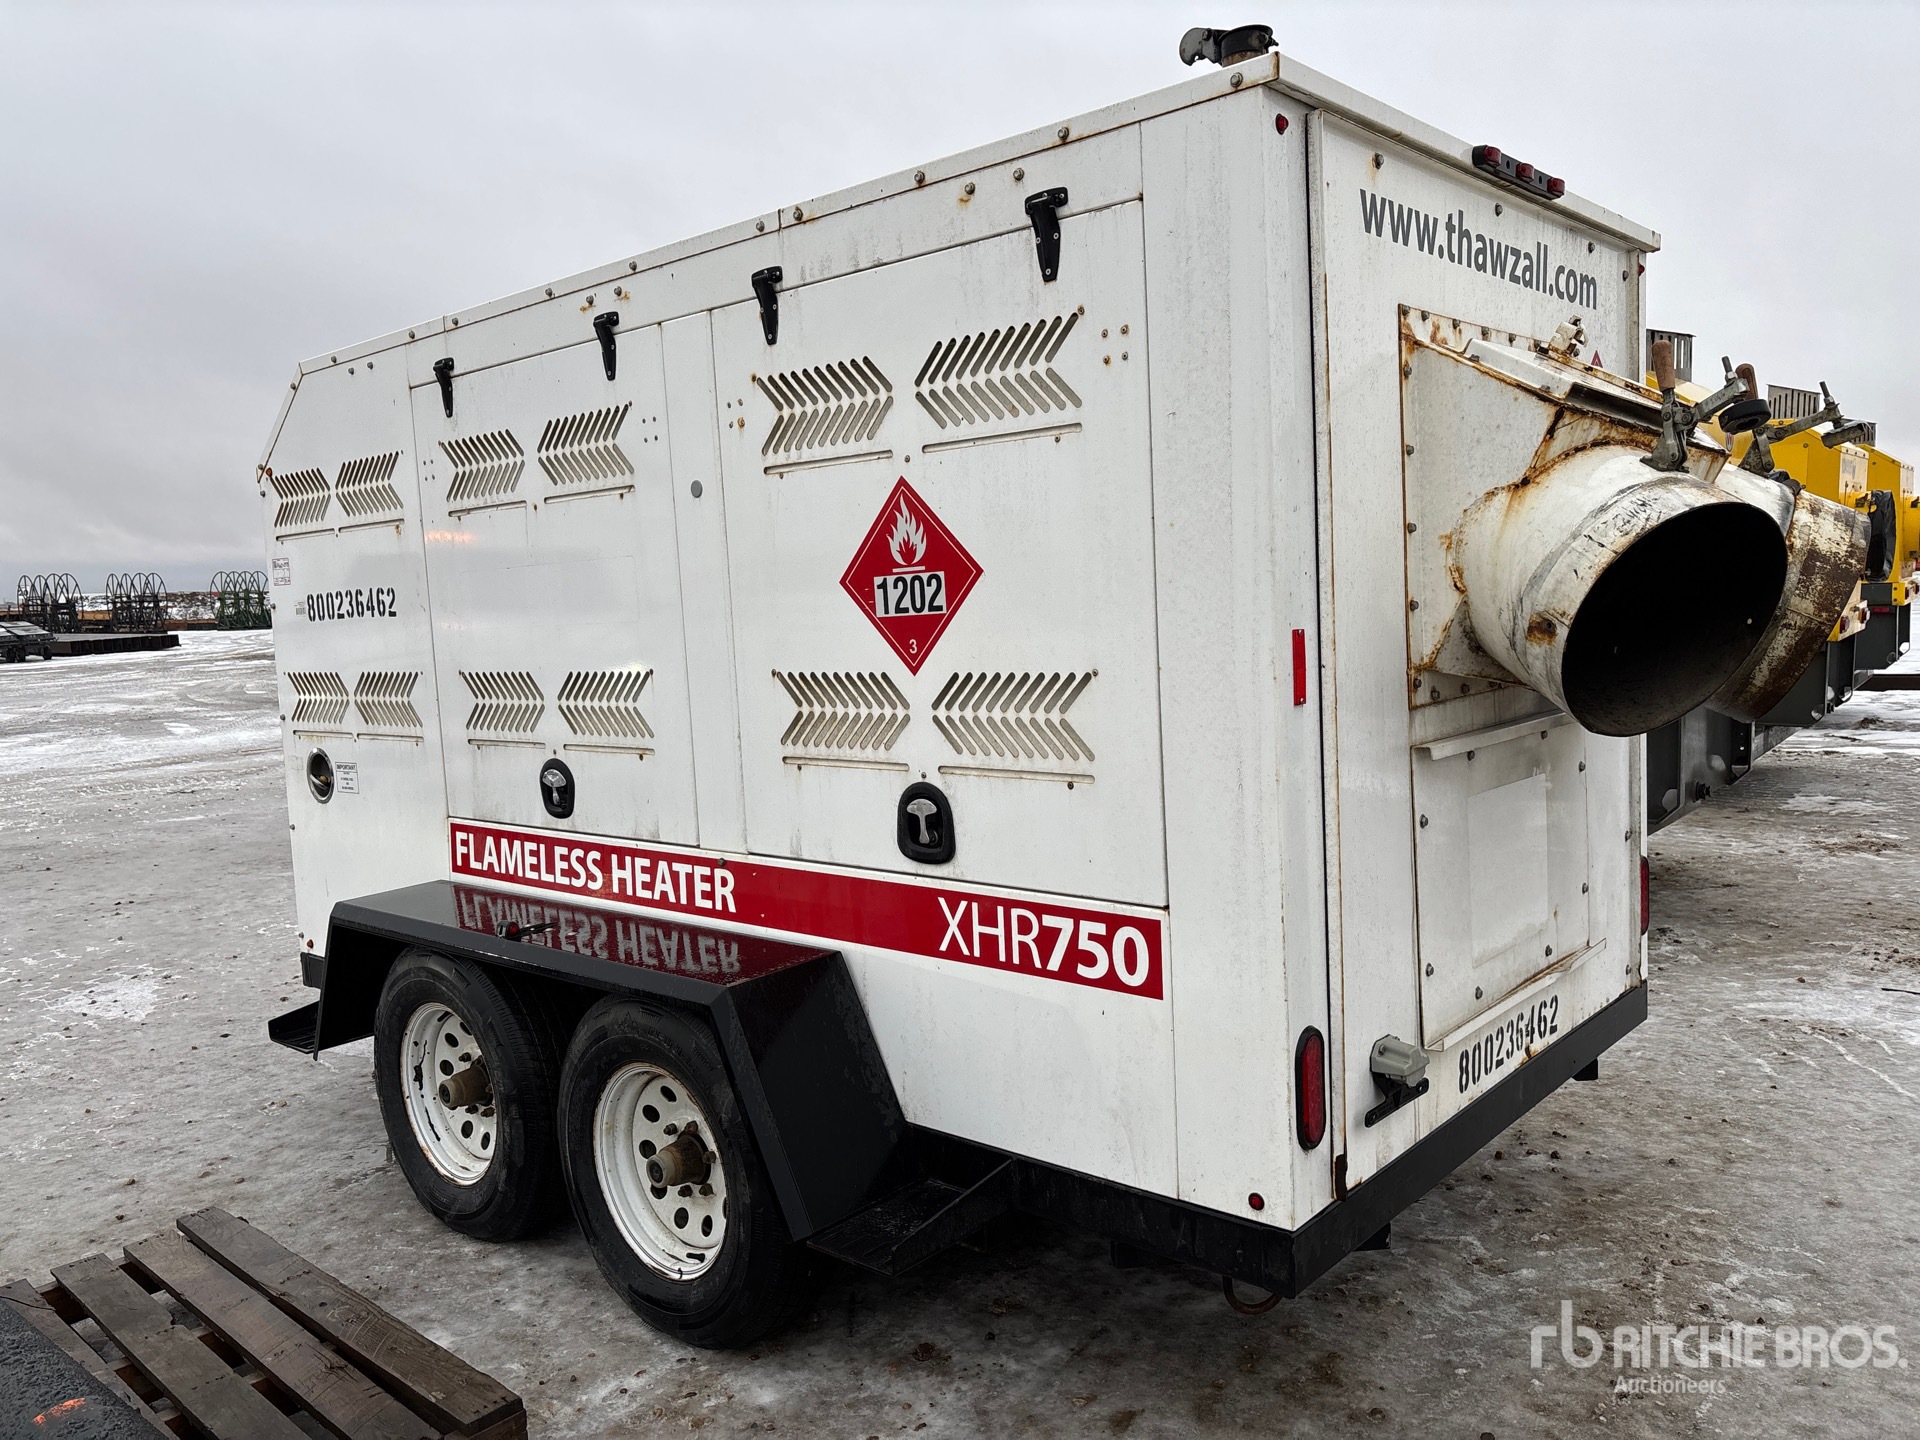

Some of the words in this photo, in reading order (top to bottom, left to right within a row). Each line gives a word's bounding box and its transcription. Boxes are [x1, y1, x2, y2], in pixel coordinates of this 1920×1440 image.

[1360, 188, 1597, 310] www.thawzall.com
[306, 587, 397, 622] 800236462
[876, 573, 944, 615] 1202
[908, 638, 918, 654] 3
[455, 831, 604, 891] FLAMELESS
[611, 853, 737, 913] HEATER
[937, 896, 1150, 987] XHR750
[1458, 994, 1559, 1094] 800236462
